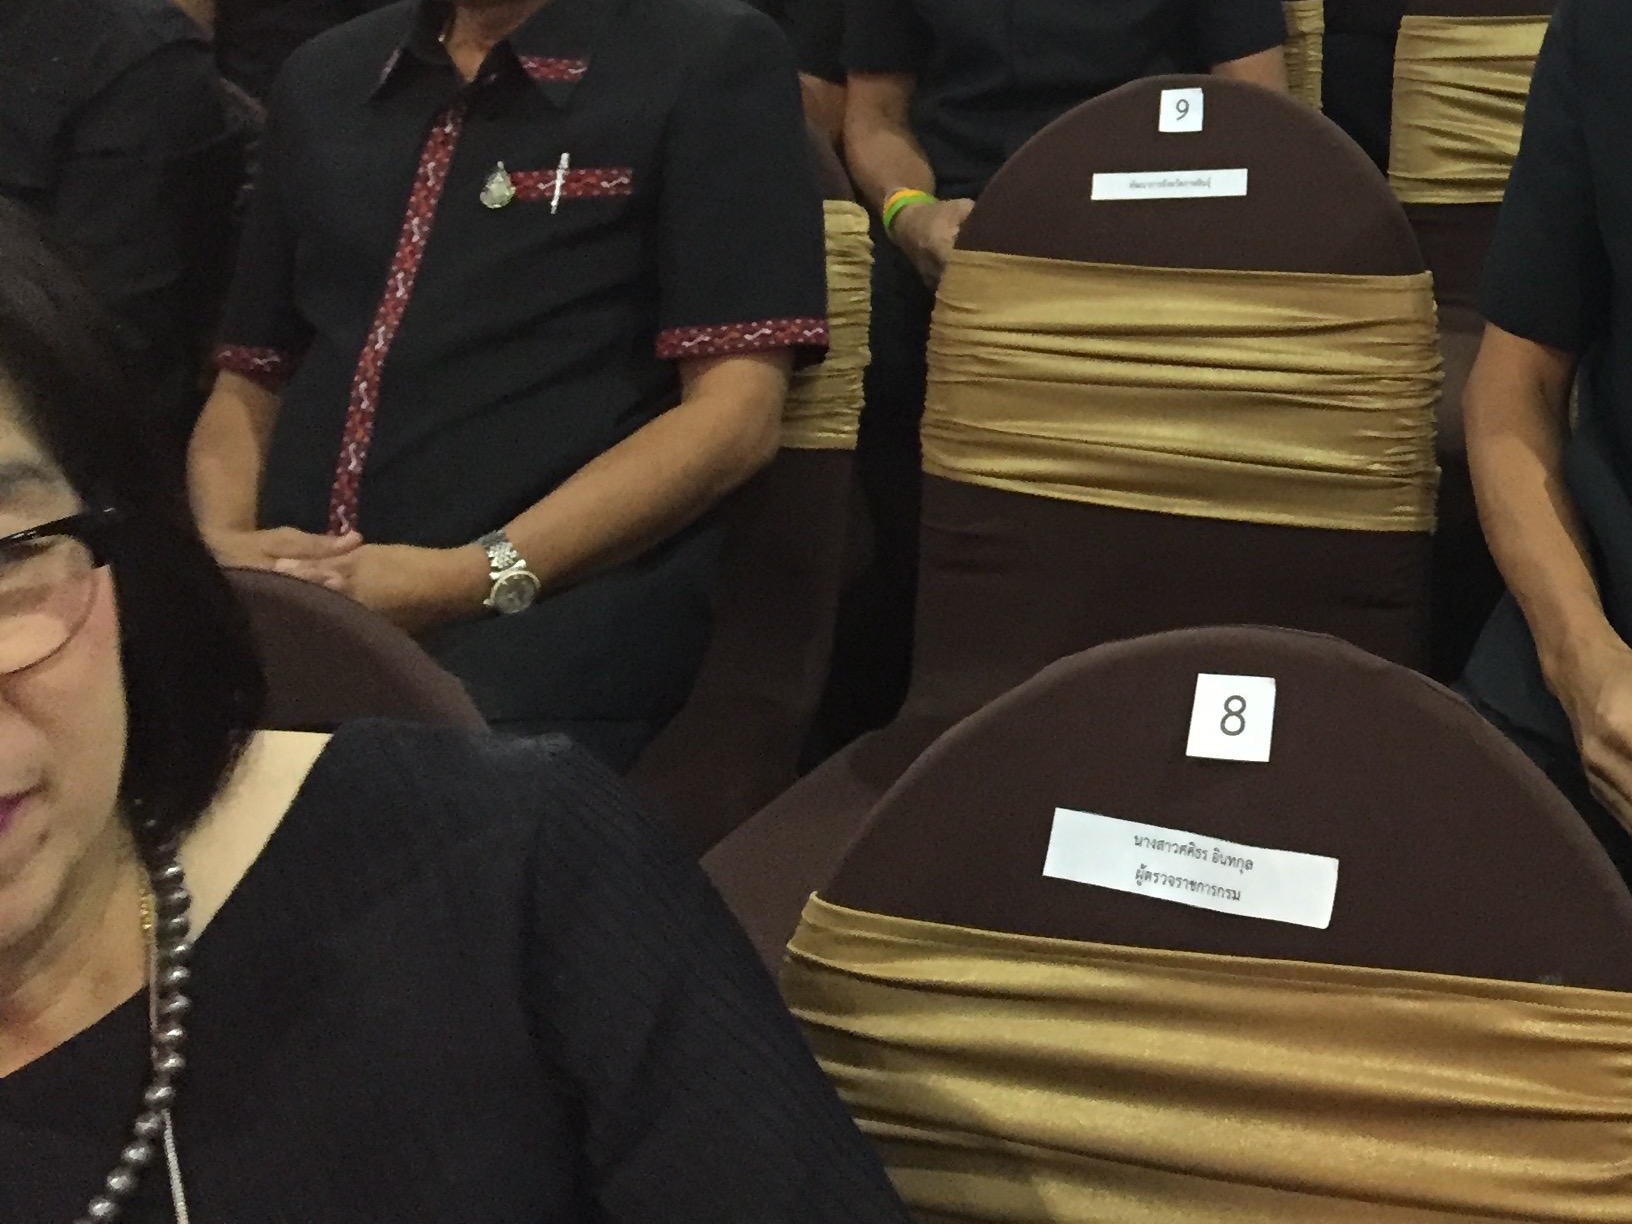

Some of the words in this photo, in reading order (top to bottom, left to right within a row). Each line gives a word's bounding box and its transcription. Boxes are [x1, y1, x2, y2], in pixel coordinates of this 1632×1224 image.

[1175, 98, 1190, 121] 9
[1219, 694, 1247, 736] 8
[1134, 862, 1242, 902] ผู้ตรวจราชการกรม
